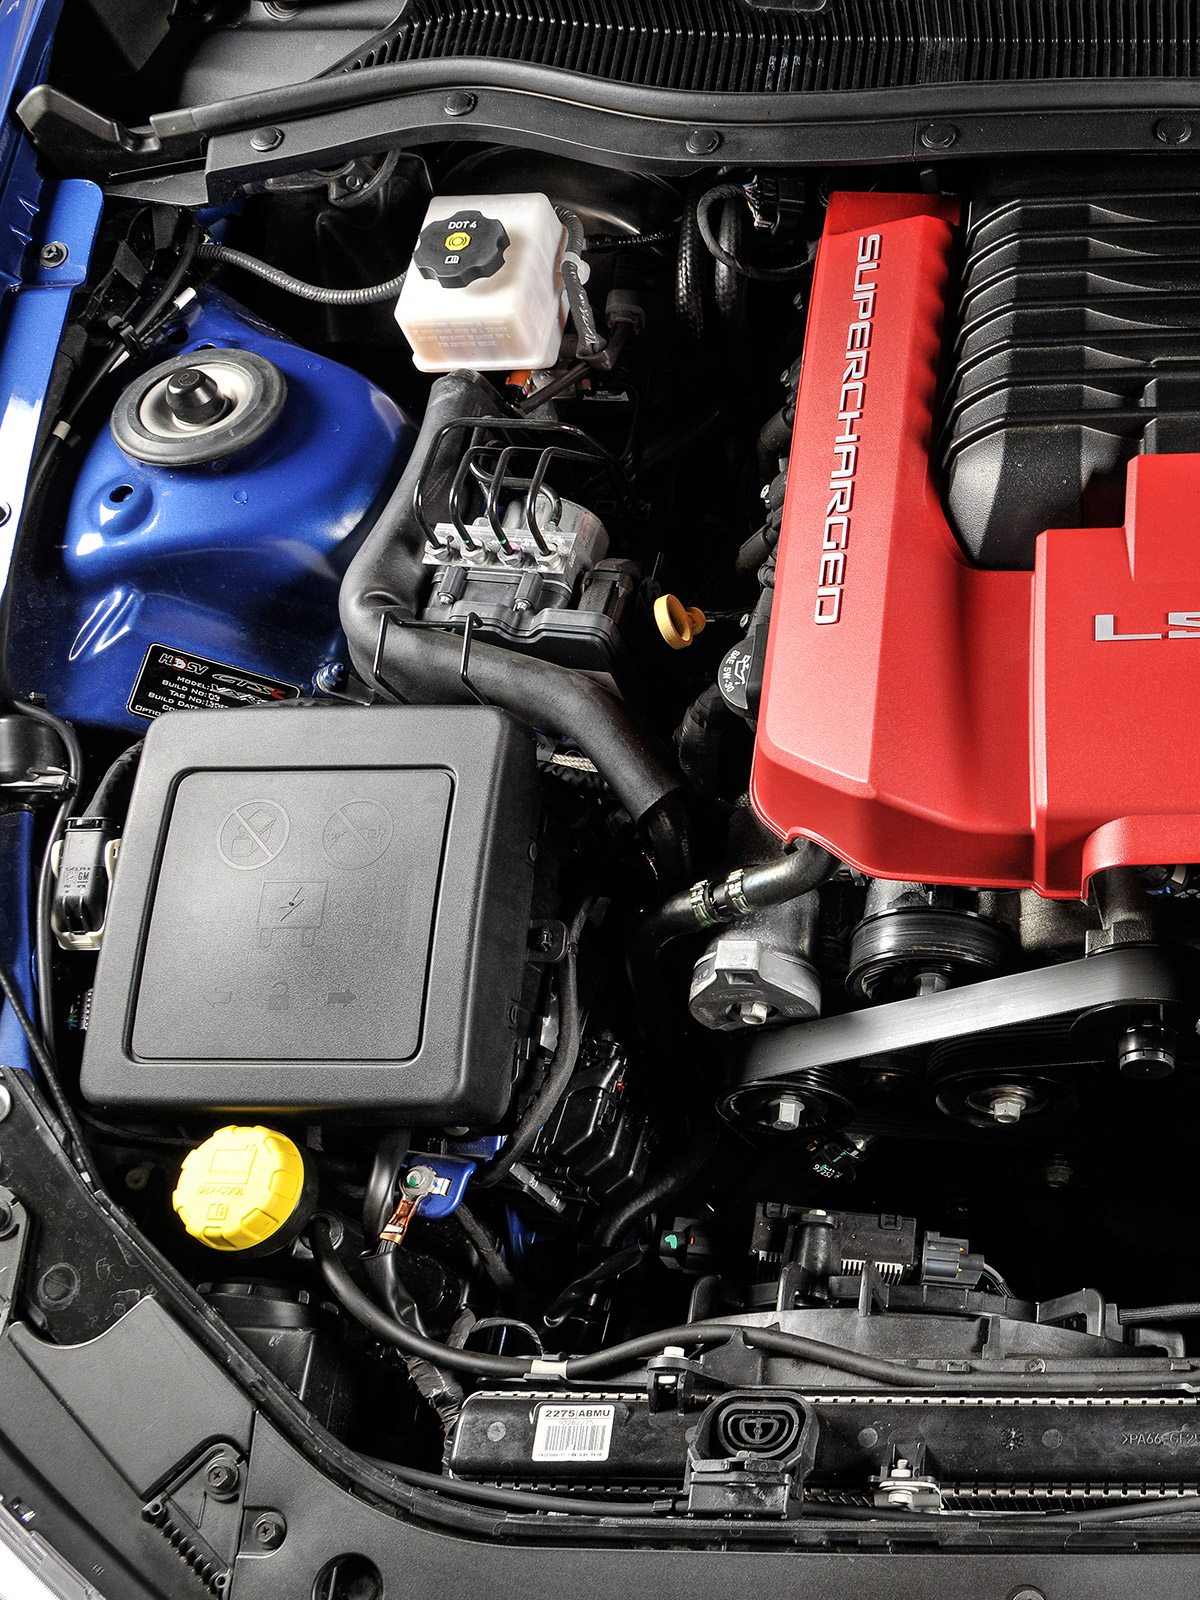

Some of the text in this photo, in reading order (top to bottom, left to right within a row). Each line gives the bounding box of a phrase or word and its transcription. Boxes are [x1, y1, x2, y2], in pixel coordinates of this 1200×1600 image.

[447, 220, 478, 230] DOT 4
[814, 233, 882, 625] SUPERCHARGED
[722, 649, 741, 693] SAE 5W-30
[161, 679, 188, 692] BUILD
[147, 691, 175, 704] BUILD
[169, 689, 186, 700] TAG
[77, 871, 90, 881] GM
[198, 1185, 245, 1196] DEX-COOL
[545, 1409, 611, 1418] 2275 ABMU
